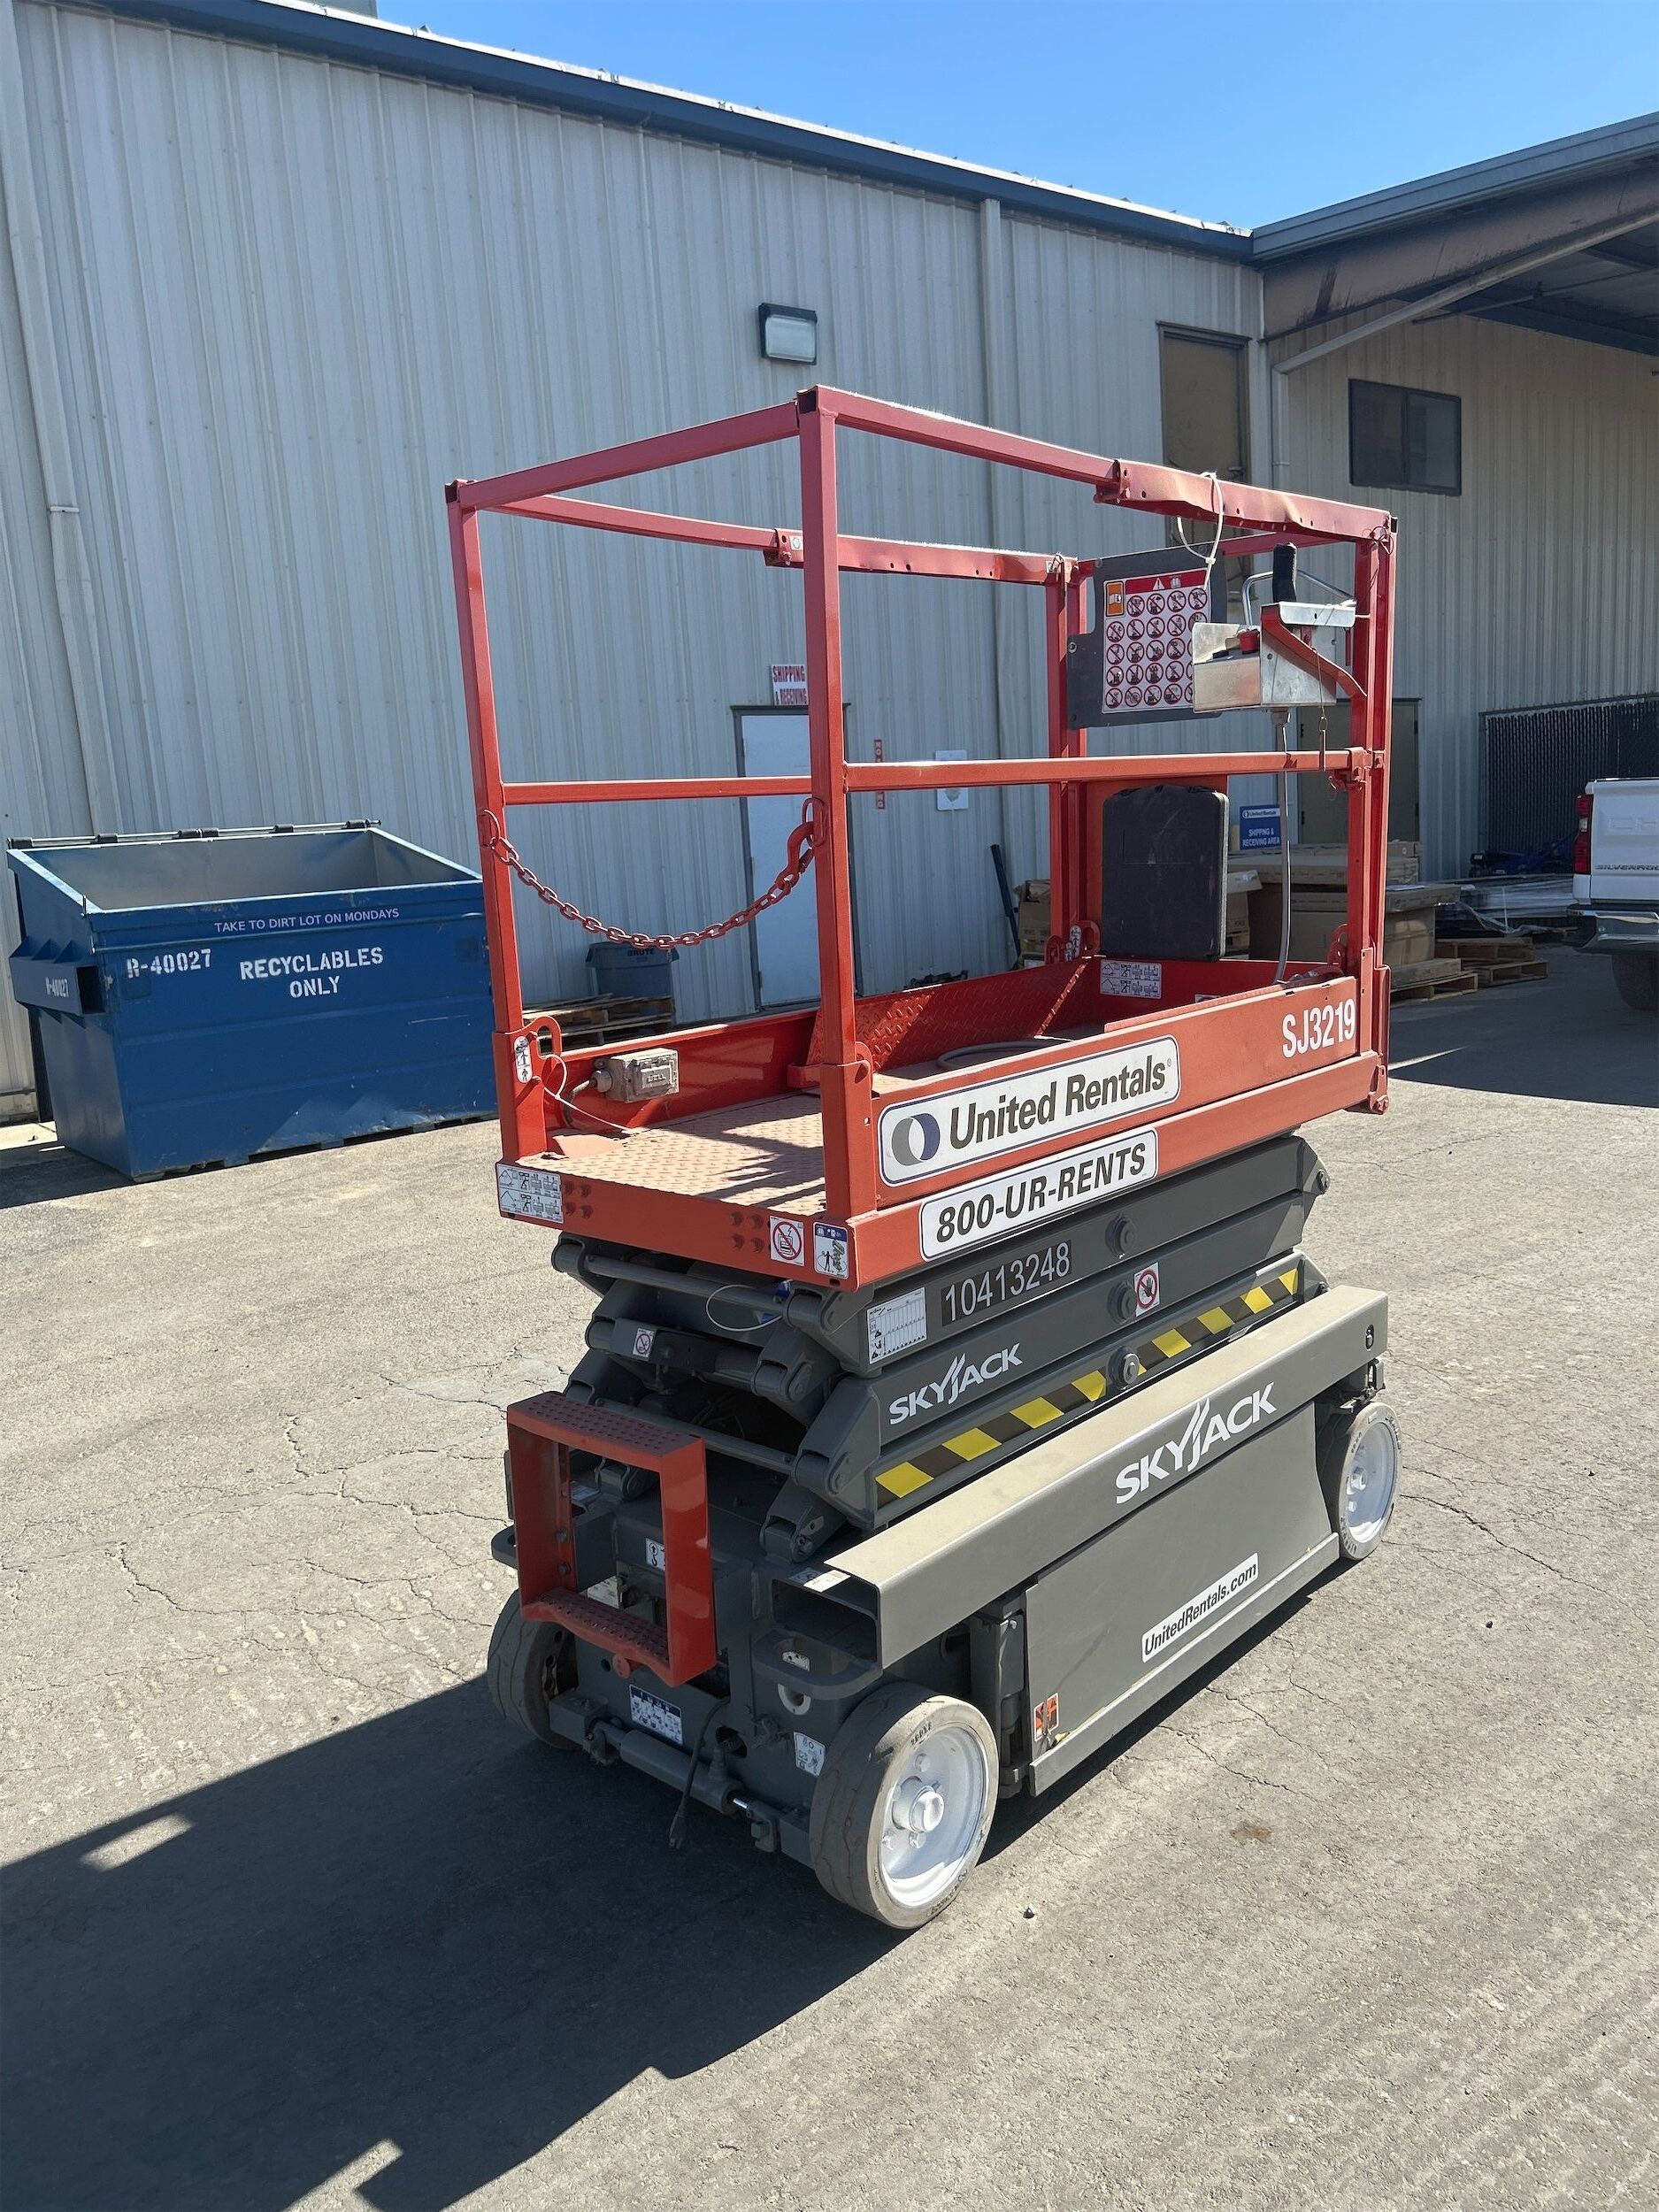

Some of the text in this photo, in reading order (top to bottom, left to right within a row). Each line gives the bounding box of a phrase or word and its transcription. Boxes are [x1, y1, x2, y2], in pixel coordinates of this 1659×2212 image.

[772, 665, 805, 682] SHIPPING
[1242, 838, 1267, 847] RECEIVING
[1248, 828, 1270, 837] SHIPPING
[214, 908, 400, 933] TAKE TO DIRT LOT ON MONDAYS
[127, 949, 211, 979] R-40027
[240, 947, 384, 979] RECYCLABLES
[289, 975, 341, 998] ONLY
[1282, 998, 1356, 1058] SJ3219
[949, 1055, 1166, 1149] United Rentals
[936, 1142, 1147, 1243] 800-UR-RENTS
[945, 1242, 1070, 1322] 10413248
[889, 1342, 1023, 1425] SKYJACK
[1116, 1381, 1278, 1504] SKYJACK
[1144, 1563, 1256, 1655] UnitedRentals.com
